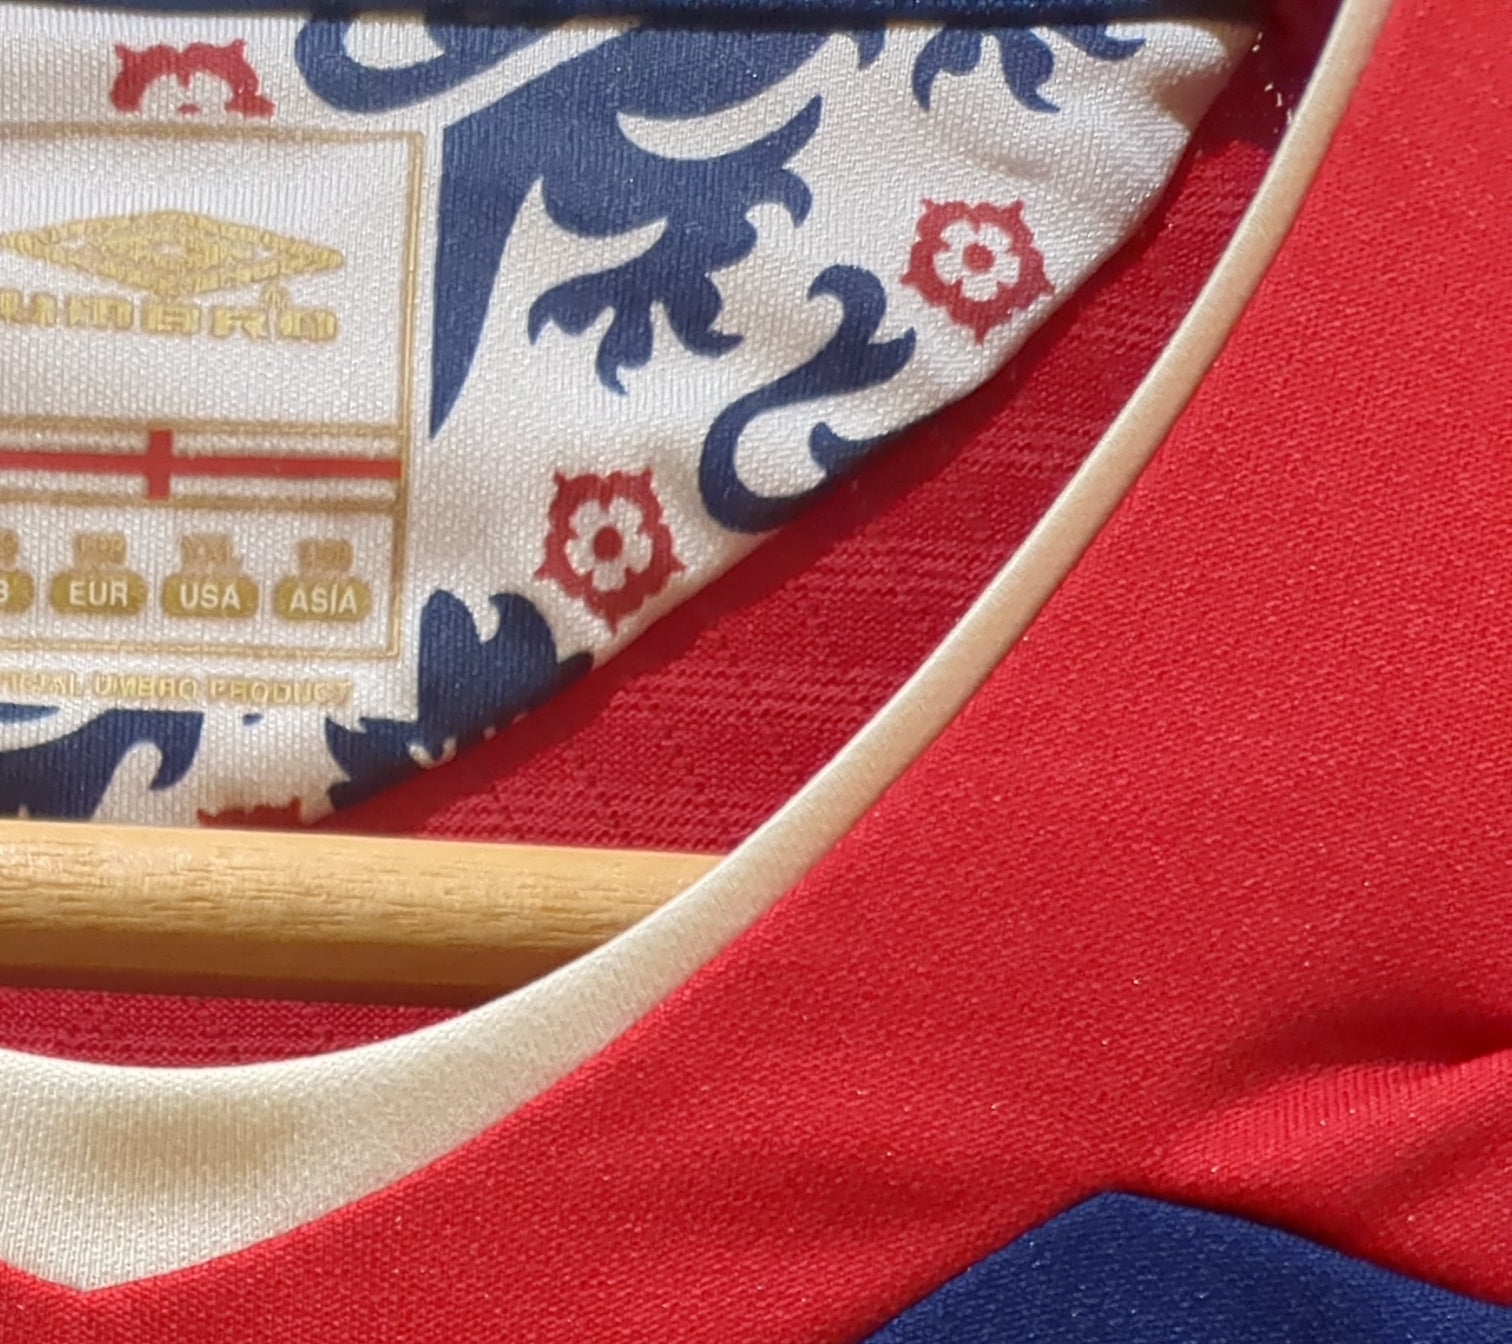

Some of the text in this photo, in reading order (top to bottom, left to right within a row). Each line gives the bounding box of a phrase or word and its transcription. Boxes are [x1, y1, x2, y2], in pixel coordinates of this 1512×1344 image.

[69, 580, 128, 608] EUR
[180, 582, 240, 611] USA
[289, 584, 357, 616] ASIA
[211, 677, 353, 706] PRODUCT
